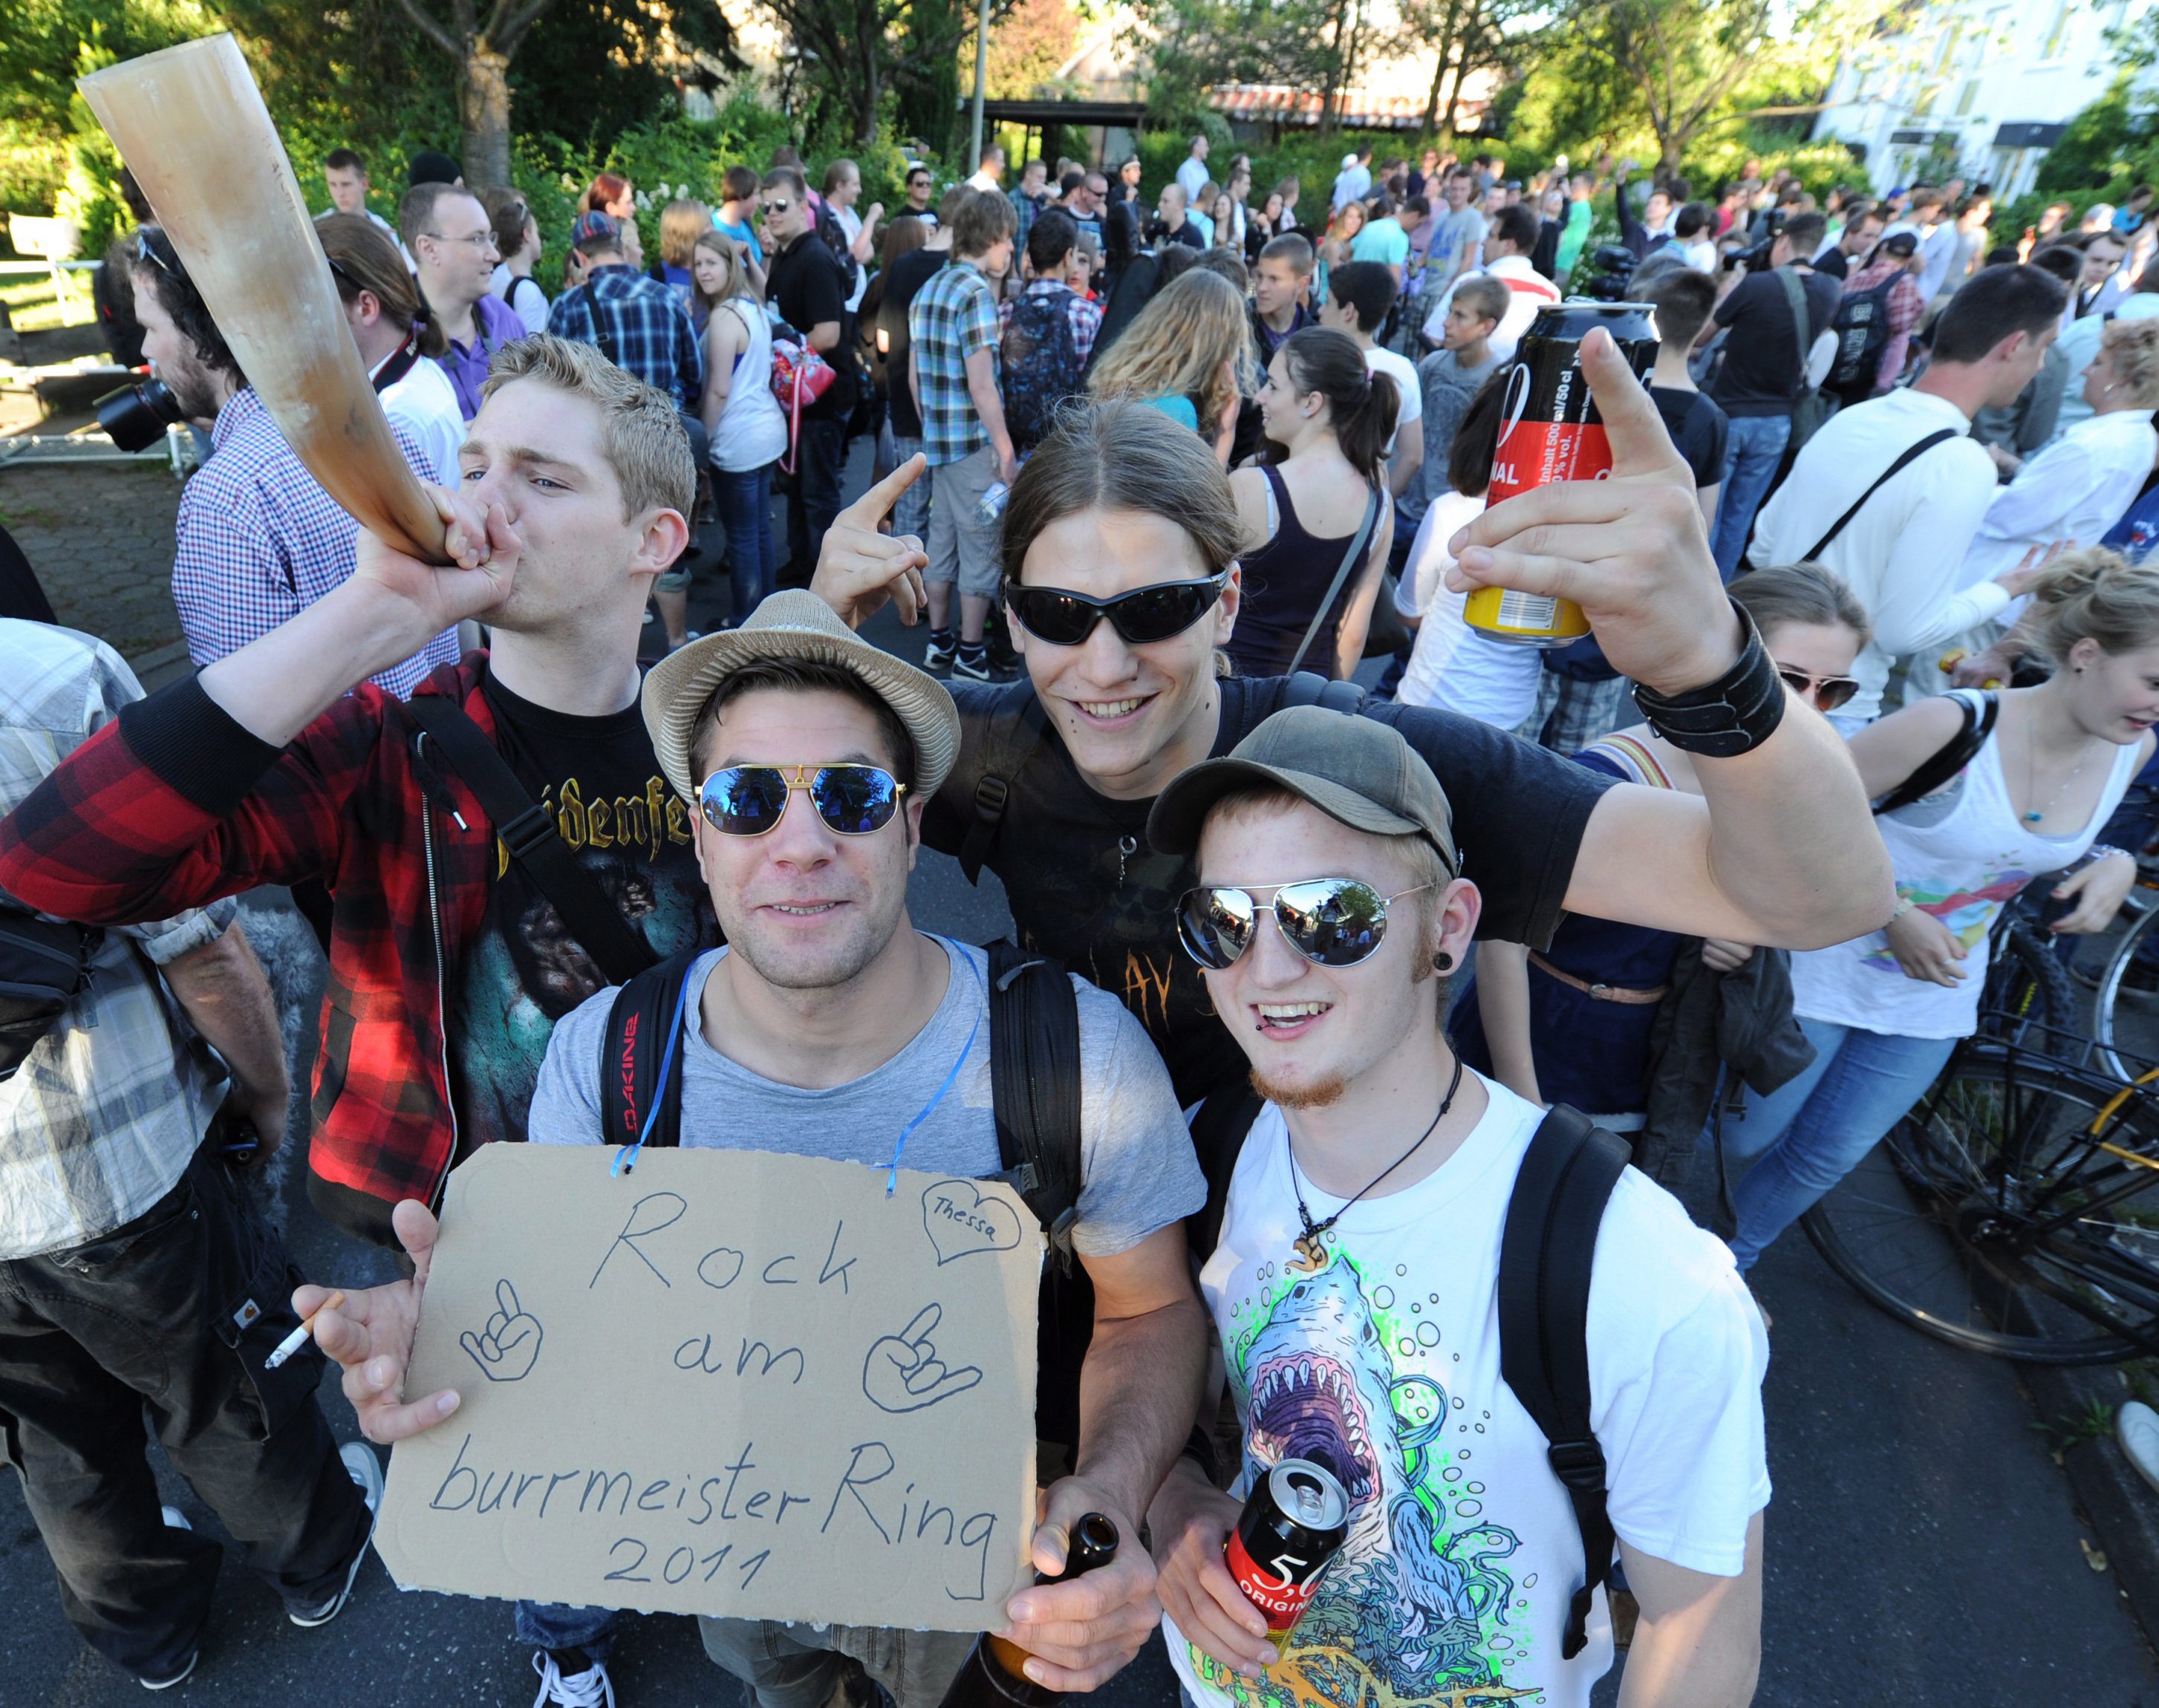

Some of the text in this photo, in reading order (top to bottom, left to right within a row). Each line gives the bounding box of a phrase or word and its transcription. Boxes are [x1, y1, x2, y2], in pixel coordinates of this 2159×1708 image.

[1539, 371, 1573, 483] Inhalt 500 ml/50 cl
[1559, 435, 1572, 459] vol.
[621, 1011, 639, 1135] DAKINE
[590, 1192, 859, 1294] Rock
[934, 1196, 996, 1242] Thessa
[674, 1334, 804, 1384] am
[821, 1442, 999, 1601] Ring
[603, 1536, 771, 1590] 2011
